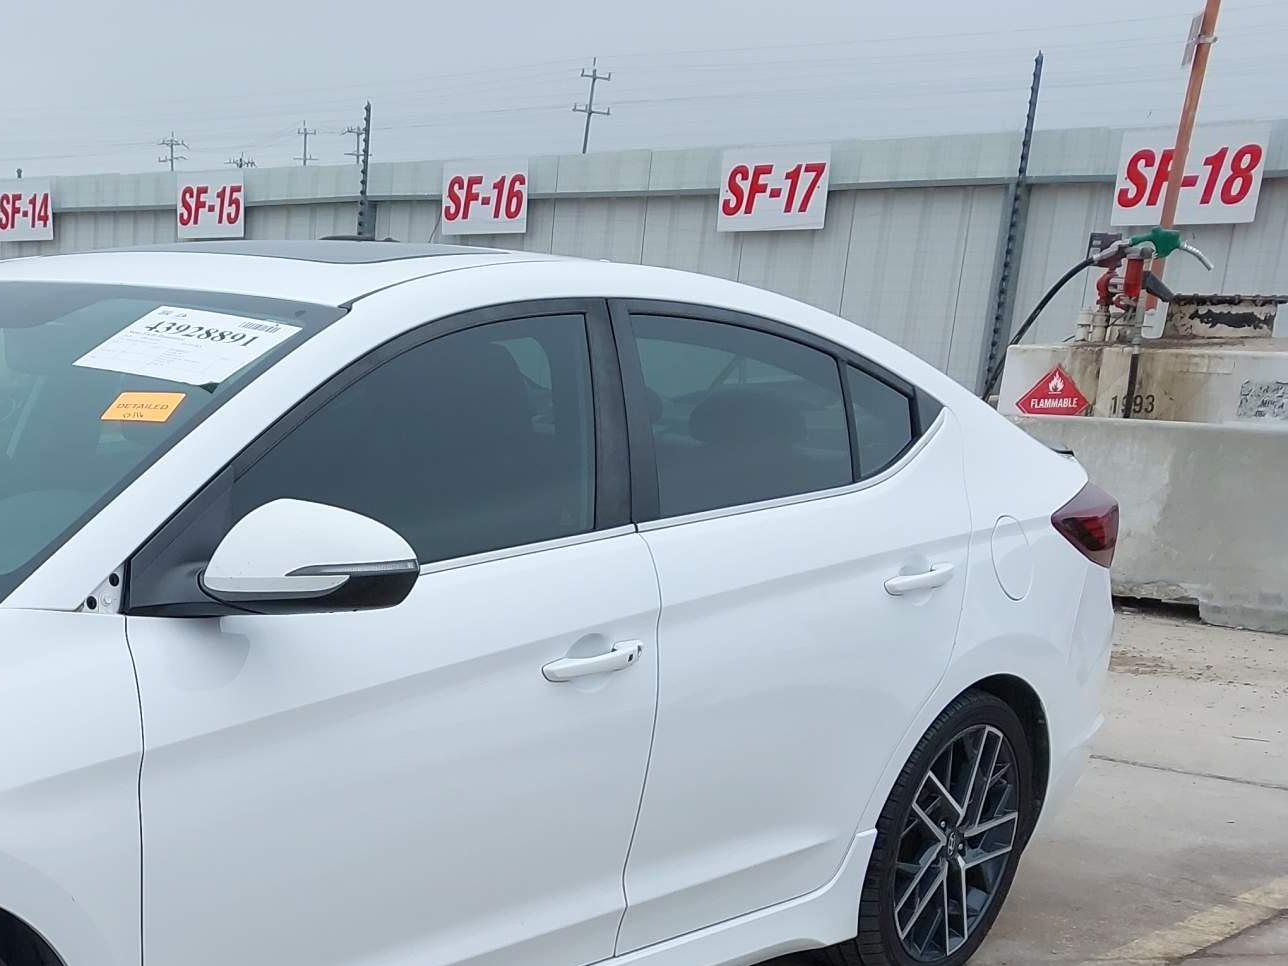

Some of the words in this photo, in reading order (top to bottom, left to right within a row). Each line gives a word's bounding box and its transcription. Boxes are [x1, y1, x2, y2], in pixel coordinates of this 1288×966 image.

[443, 174, 527, 222] SF-16
[721, 163, 826, 217] SF-17
[1116, 143, 1264, 209] SF-18
[178, 185, 243, 226] SF-15
[144, 320, 259, 347] 43928891
[1030, 397, 1079, 409] FLAMMABLE
